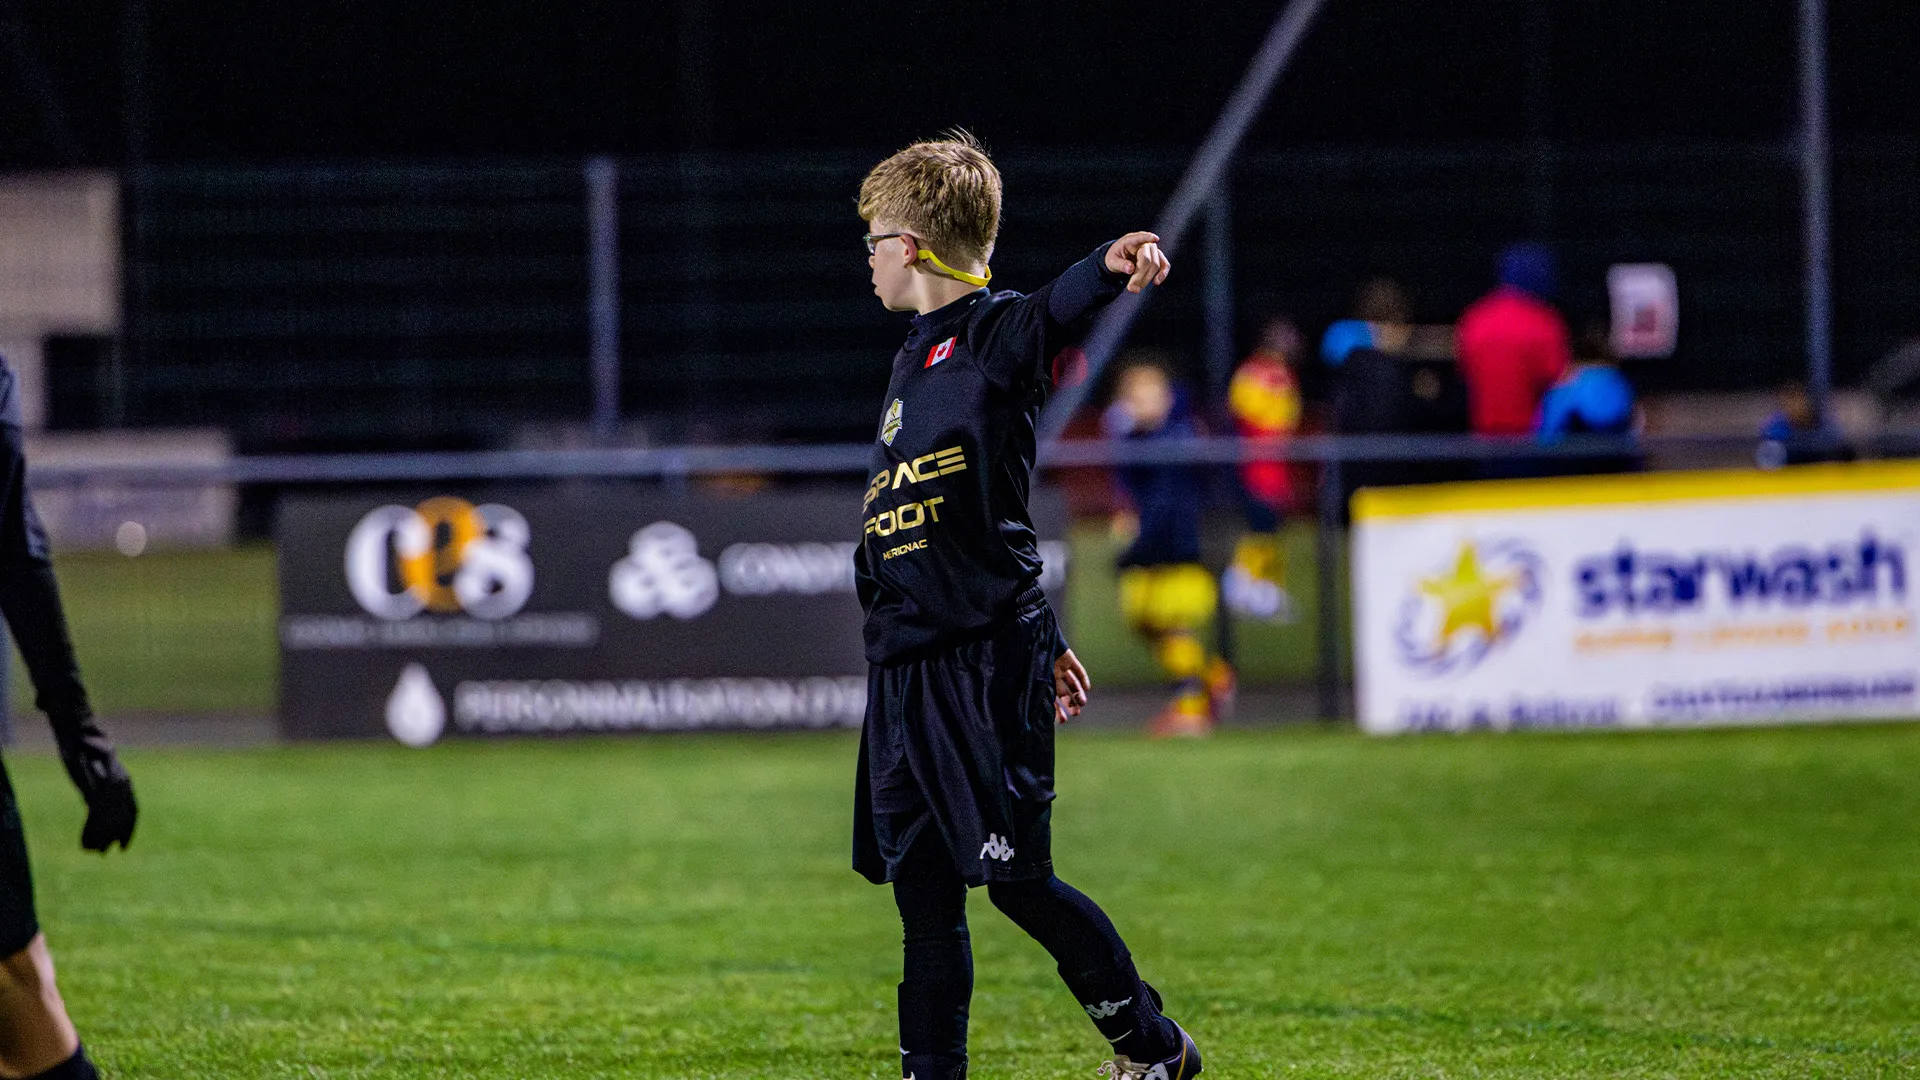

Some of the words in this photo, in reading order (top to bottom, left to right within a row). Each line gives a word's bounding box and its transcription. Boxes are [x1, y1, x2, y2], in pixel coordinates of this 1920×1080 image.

[863, 496, 945, 541] FOOT
[883, 538, 928, 561] MERIGNAC
[1572, 526, 1909, 618] starwash
